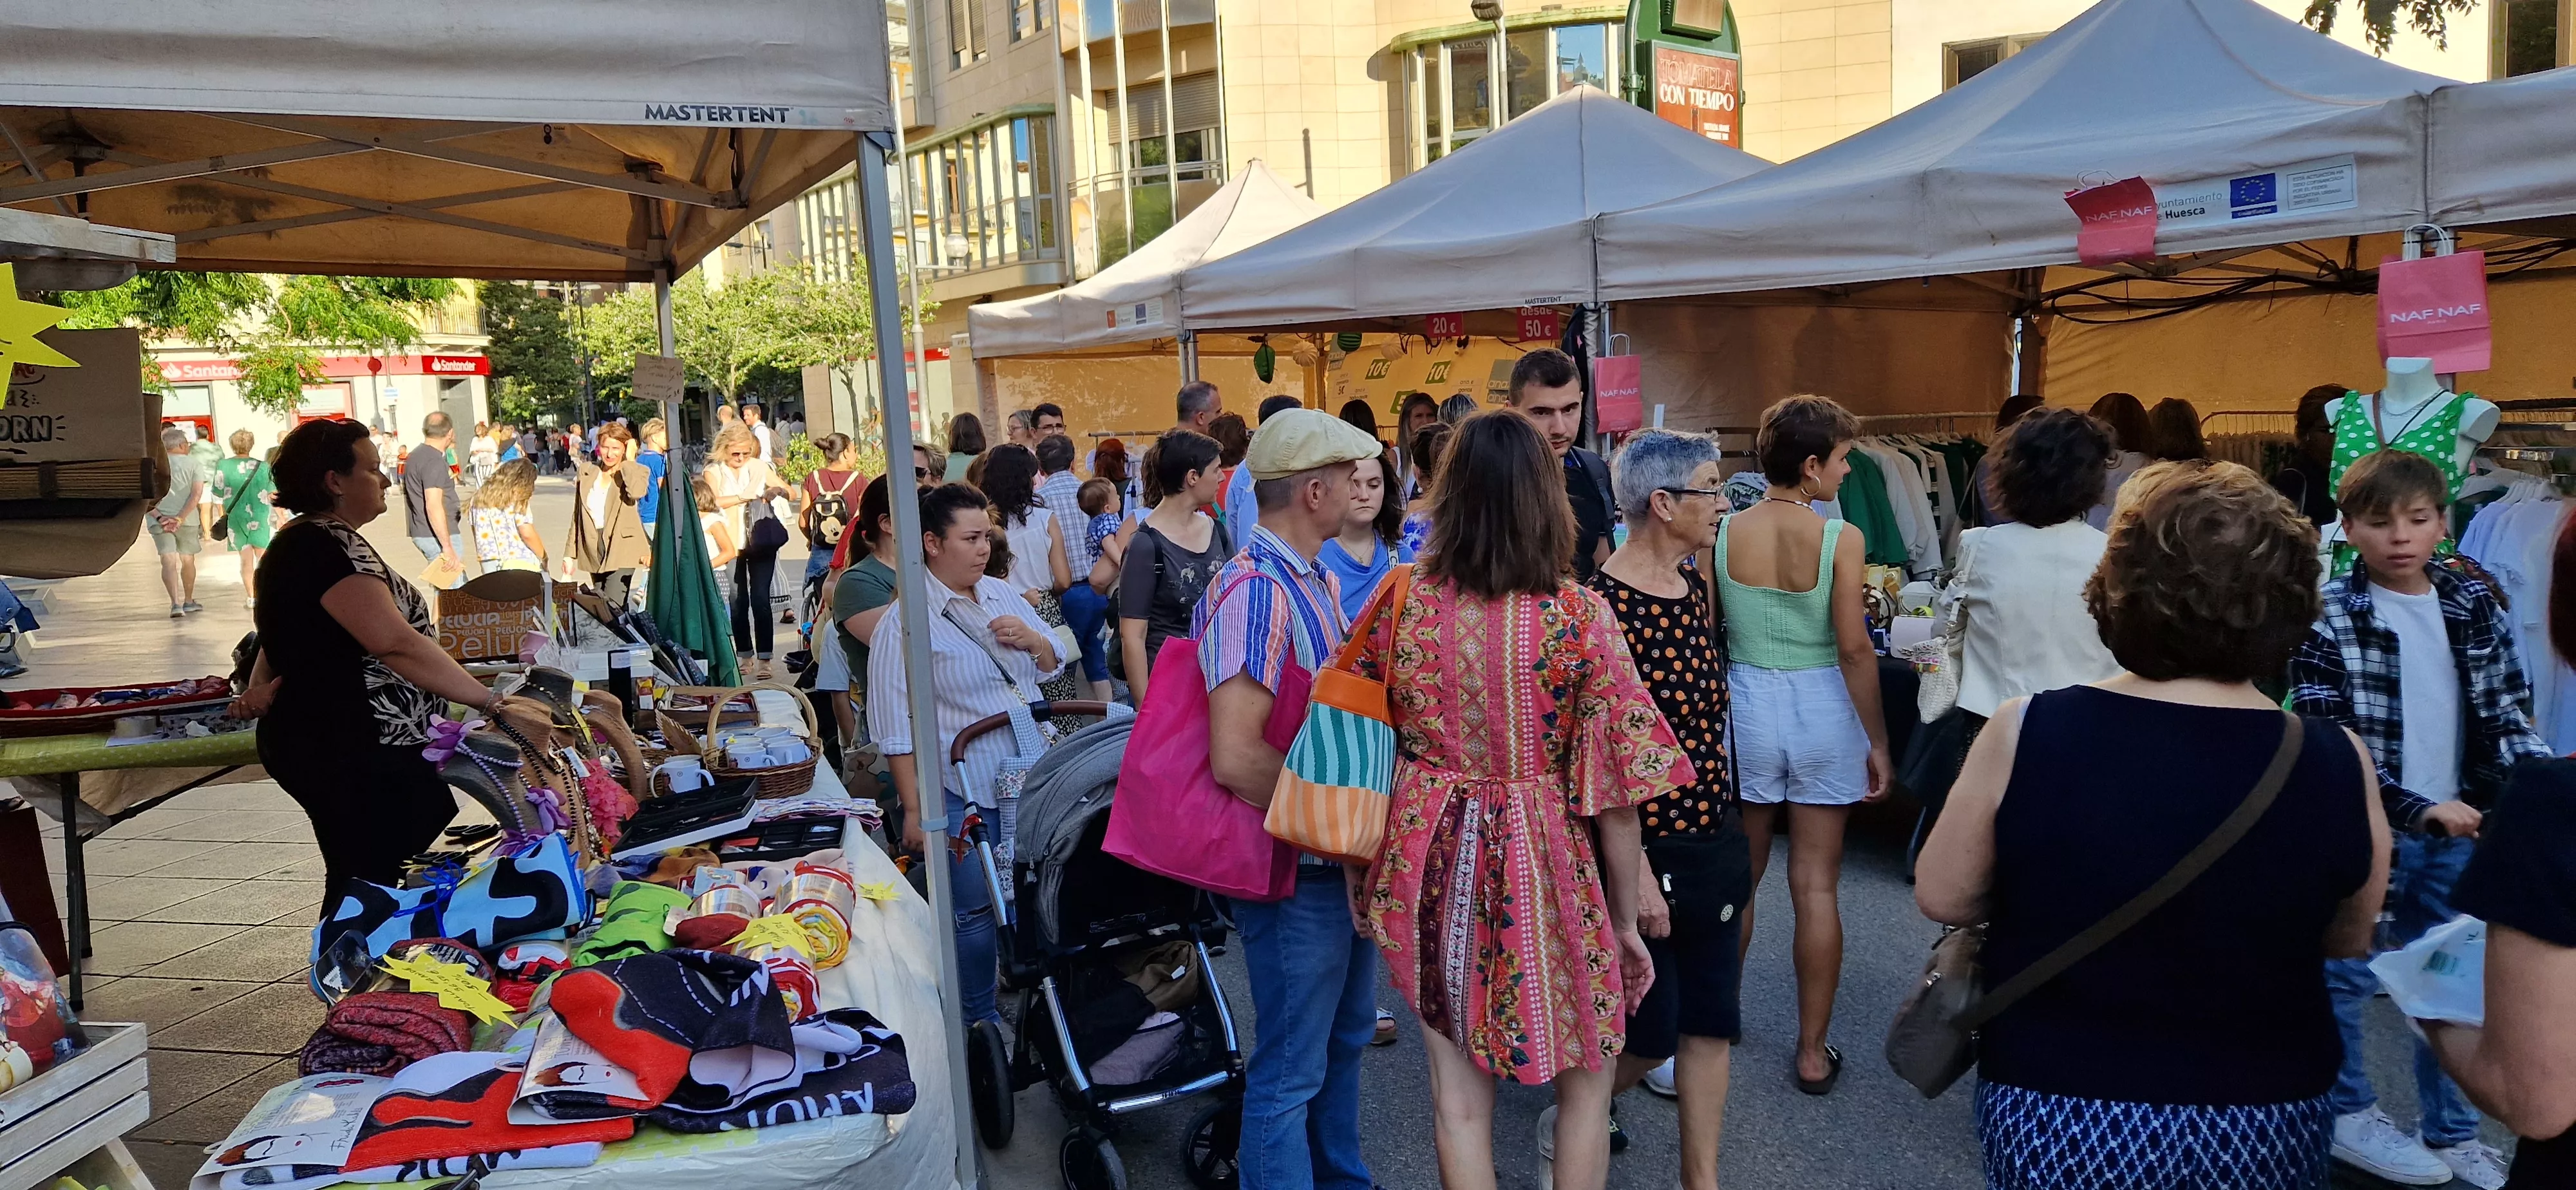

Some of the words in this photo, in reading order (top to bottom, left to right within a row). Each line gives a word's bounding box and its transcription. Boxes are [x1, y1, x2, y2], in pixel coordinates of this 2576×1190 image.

[1660, 55, 1734, 91] TÓMATELA
[1660, 84, 1685, 106] CON
[1688, 88, 1734, 111] TIEMPO
[645, 103, 790, 123] MASTERTENT
[2157, 191, 2222, 212] yuntamiento
[2085, 210, 2117, 222] NAF
[2120, 206, 2153, 218] NAF
[2166, 206, 2205, 219] Huesca
[1524, 296, 1562, 305] MASTERTENT
[2390, 309, 2434, 323] NAF
[2438, 303, 2481, 317] NAF
[1433, 317, 1447, 334] 20
[1450, 323, 1456, 333] €
[1525, 319, 1541, 337] 50
[1544, 325, 1551, 336] €
[183, 364, 240, 378] Santan
[440, 359, 477, 372] Santander
[1368, 361, 1391, 377] 10€
